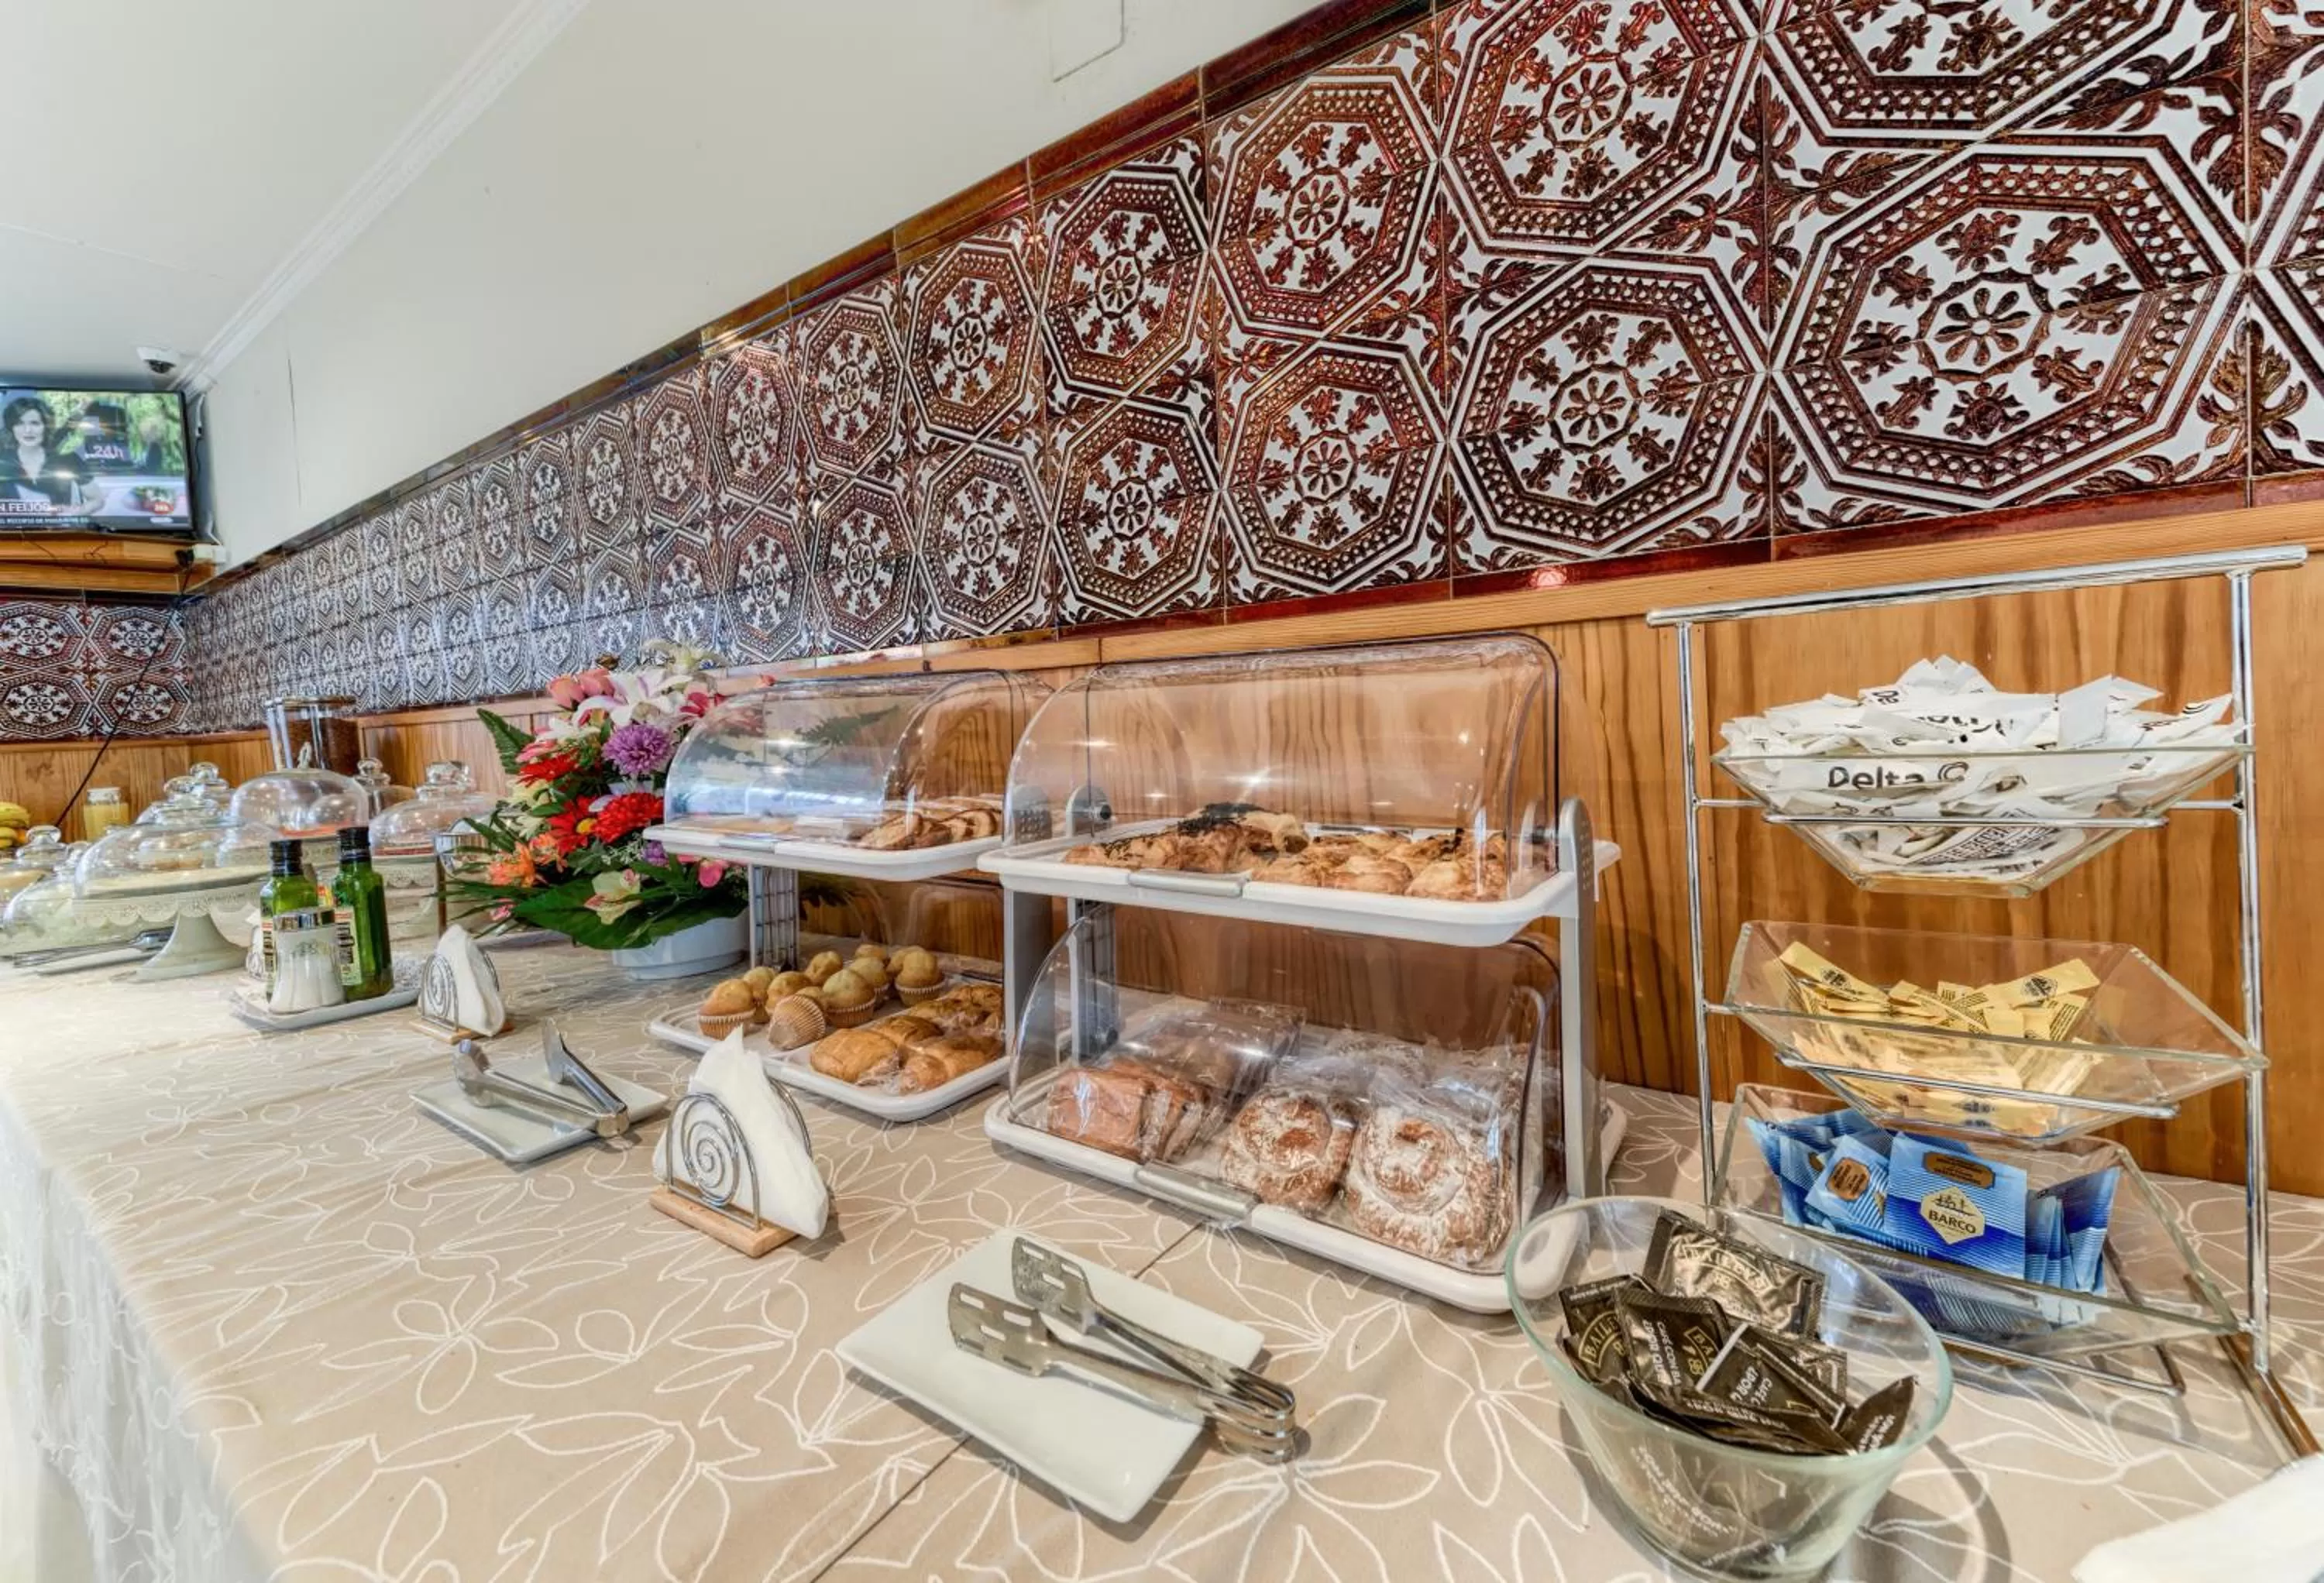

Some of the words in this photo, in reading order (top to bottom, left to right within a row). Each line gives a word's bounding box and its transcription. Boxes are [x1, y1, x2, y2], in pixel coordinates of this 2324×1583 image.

[1828, 766, 1926, 789] Delta
[1928, 1209, 1976, 1234] BARCO
[1584, 1316, 1622, 1358] BAILE
